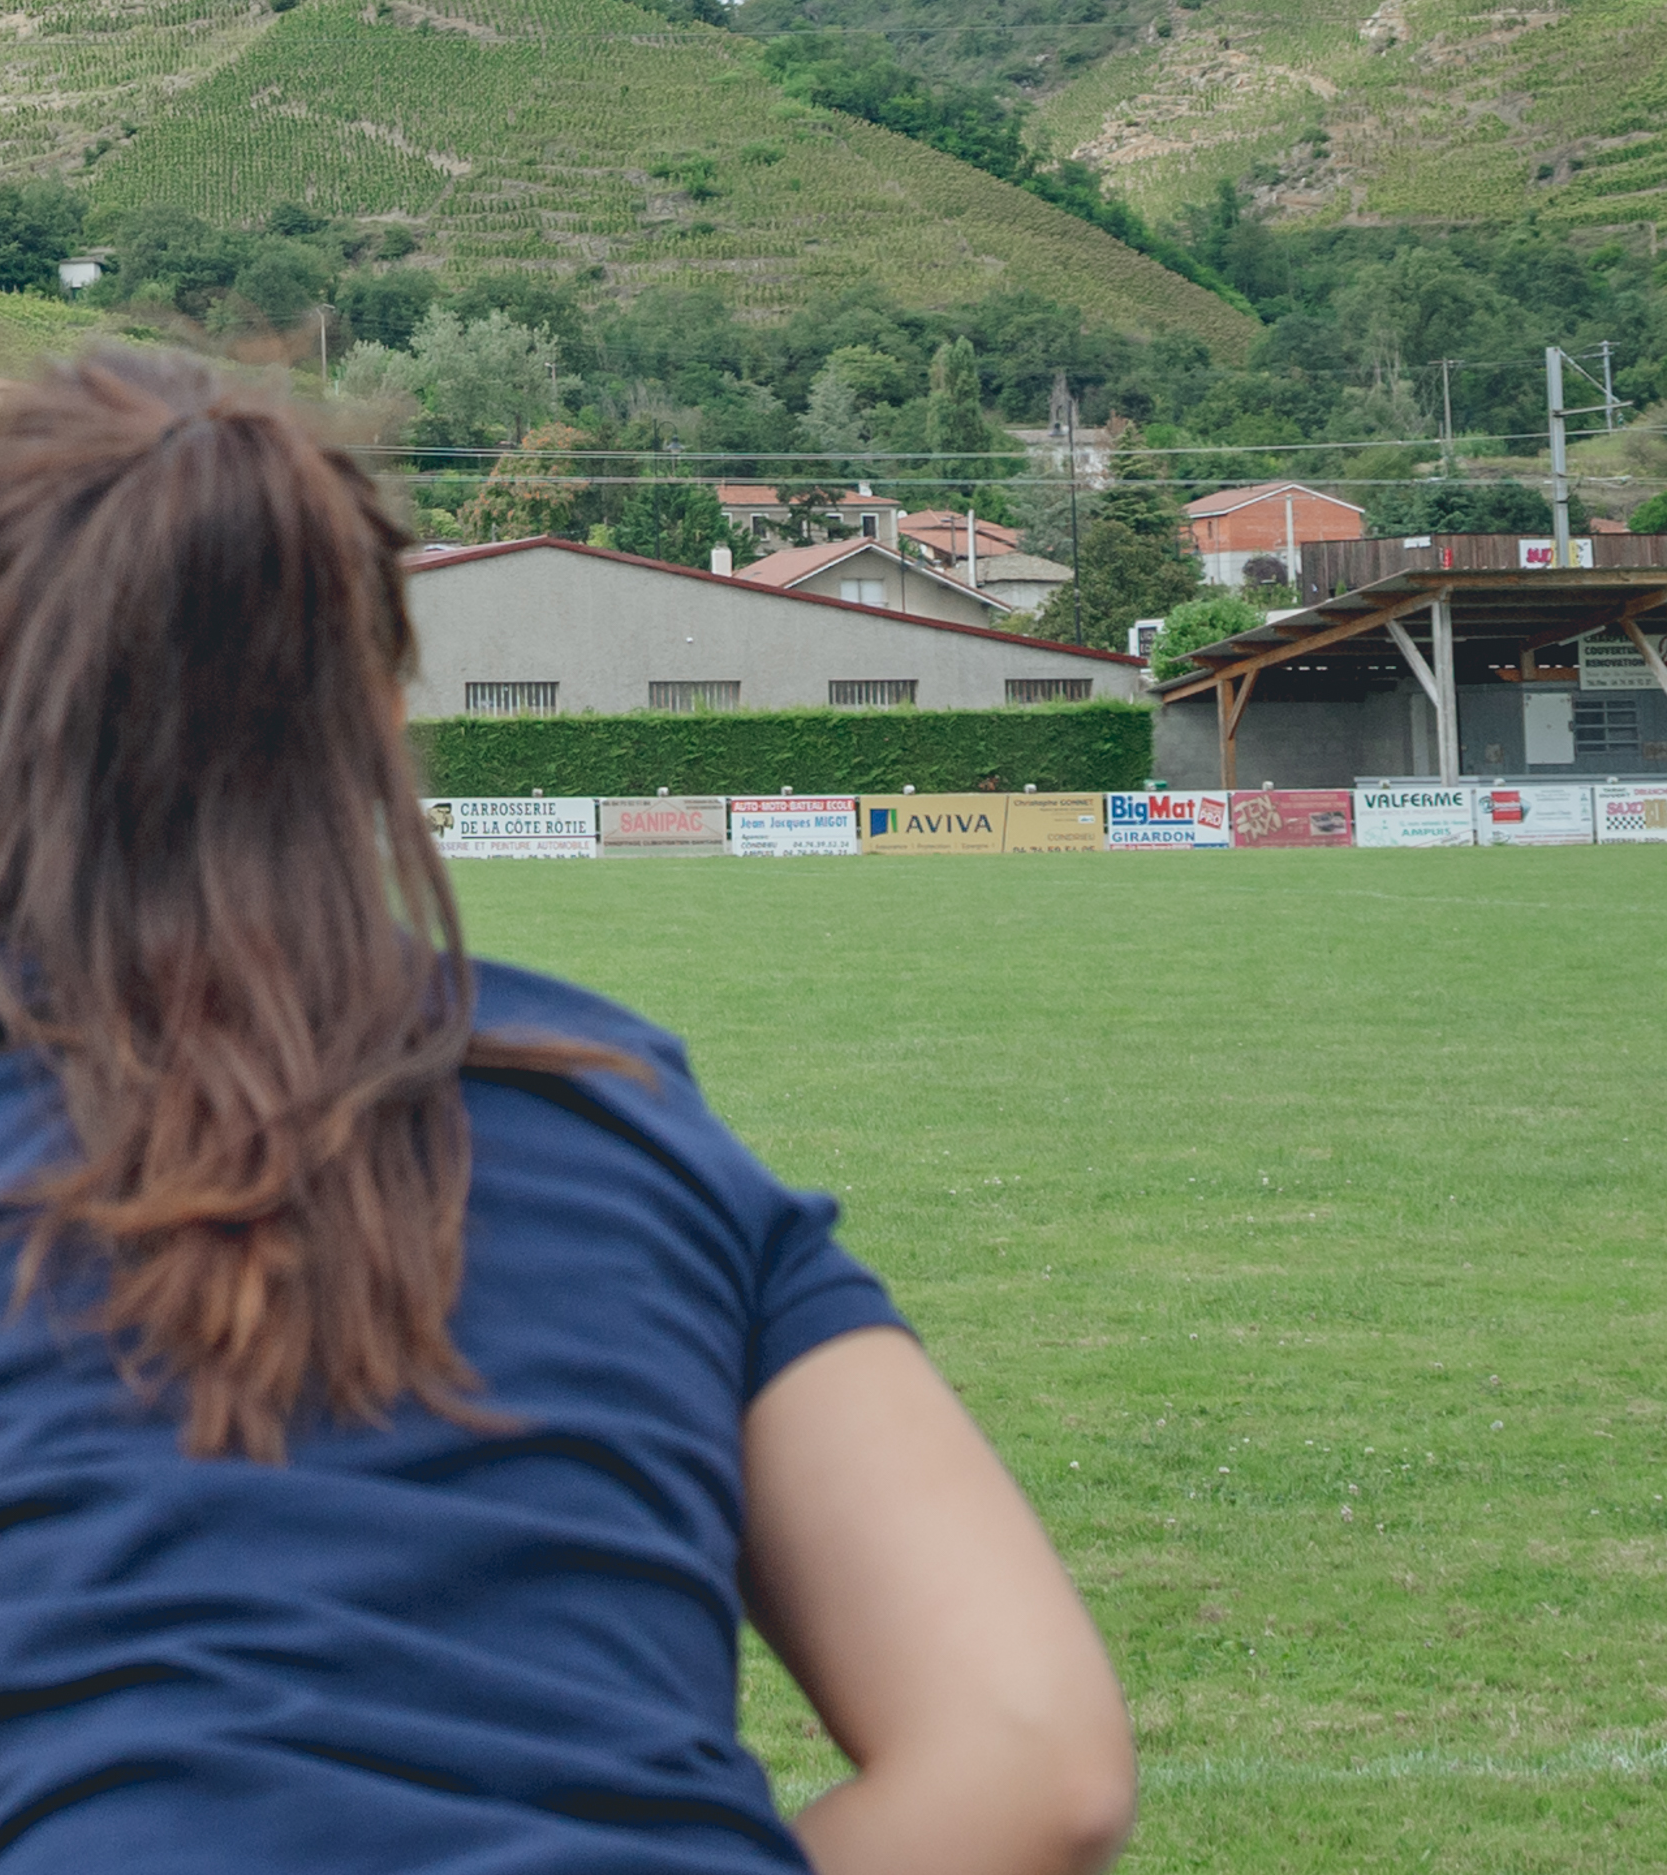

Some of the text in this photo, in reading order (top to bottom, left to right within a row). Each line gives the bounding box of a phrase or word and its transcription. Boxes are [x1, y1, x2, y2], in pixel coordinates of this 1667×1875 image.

[460, 802, 556, 816] CARROSSERIE
[1364, 791, 1464, 809] VALFERME
[1111, 795, 1196, 825] BigMat
[461, 817, 587, 835] DE LA CÔTE RÔTIE
[620, 811, 704, 833] SANIPAC
[740, 815, 848, 831] Jean Jacques MIGOT
[906, 814, 993, 834] AVIVA
[438, 841, 470, 851] SSERIE
[475, 841, 485, 851] ET
[537, 841, 590, 850] AUTOMOBILE
[1111, 831, 1196, 843] GIRARDON
